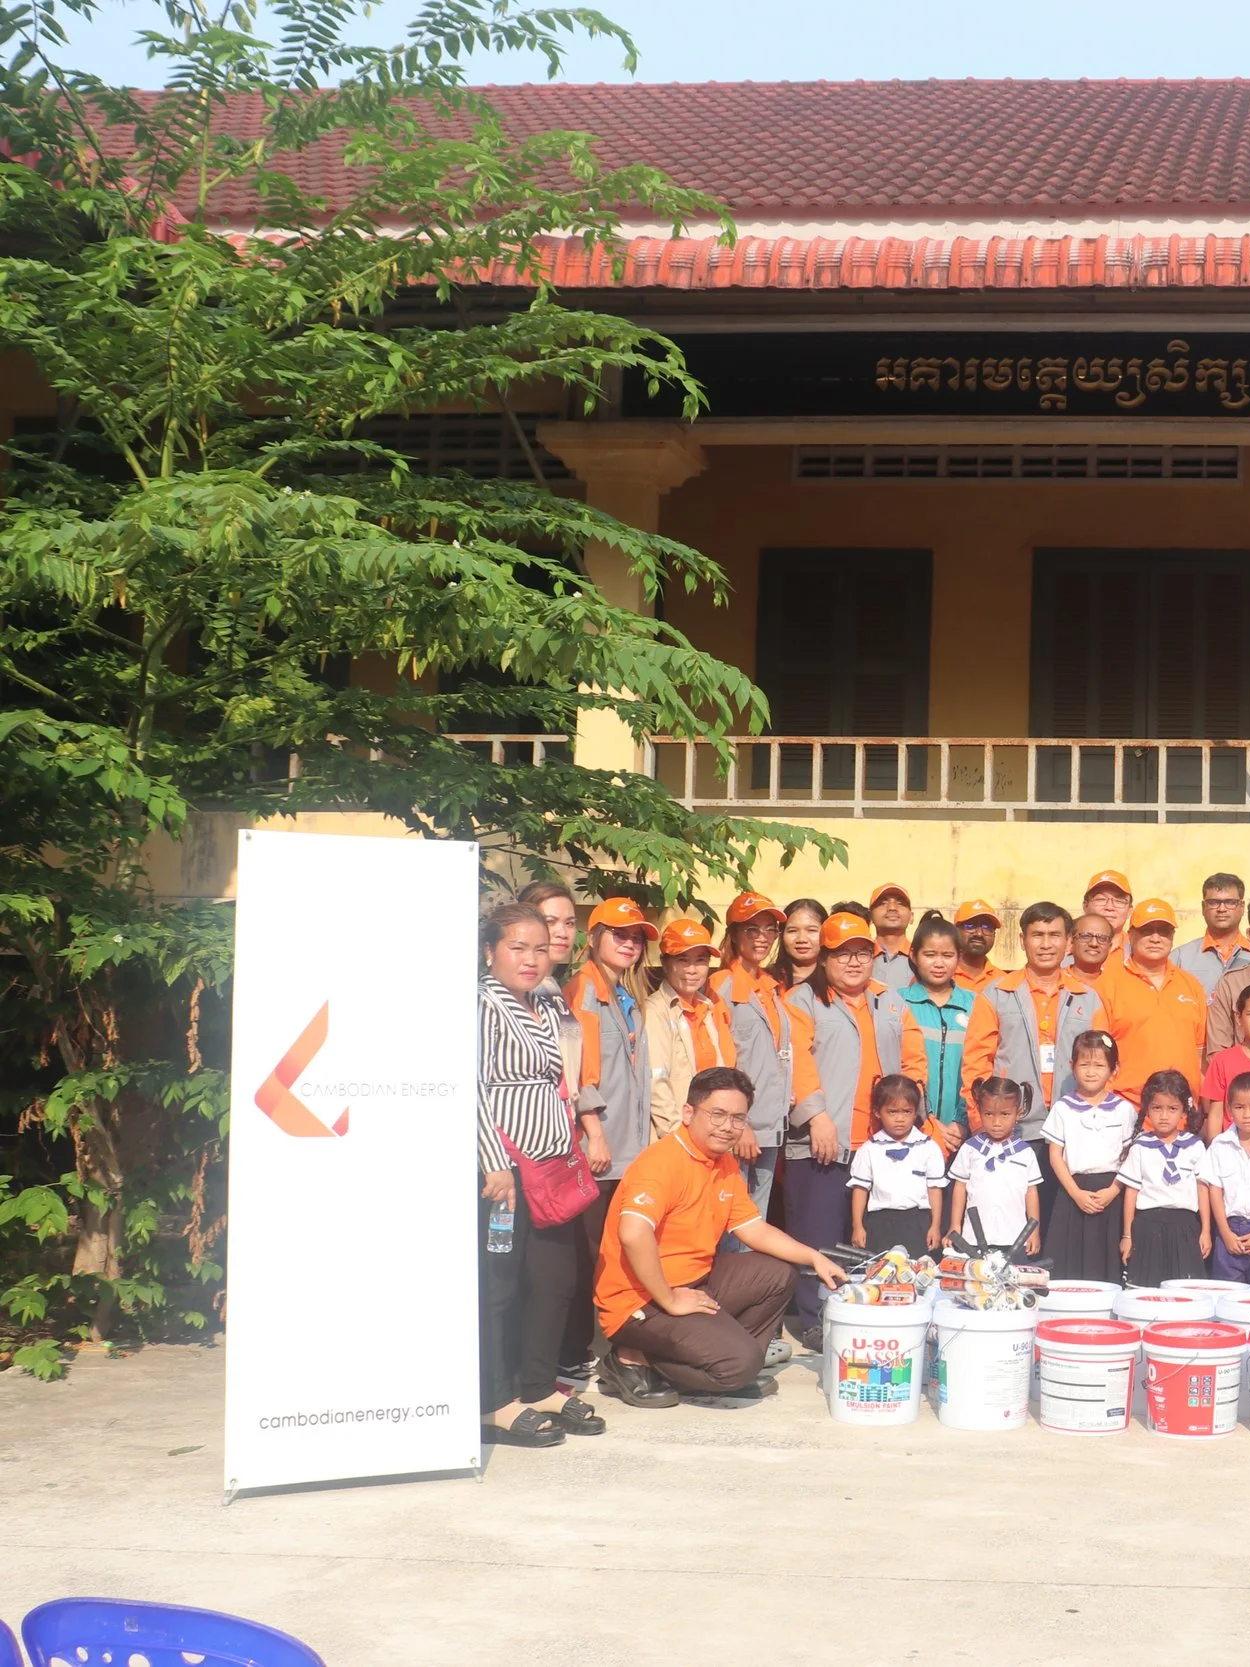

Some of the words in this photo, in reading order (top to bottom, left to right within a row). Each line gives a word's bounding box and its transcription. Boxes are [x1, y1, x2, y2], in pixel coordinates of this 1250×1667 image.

[300, 1082, 397, 1097] CAMBODIAN
[401, 1082, 458, 1097] ENERGY
[852, 1338, 900, 1351] U-90
[841, 1348, 911, 1369] CLASSIC
[846, 1401, 881, 1409] EMULSION
[258, 1403, 450, 1430] cambodianenergy.com
